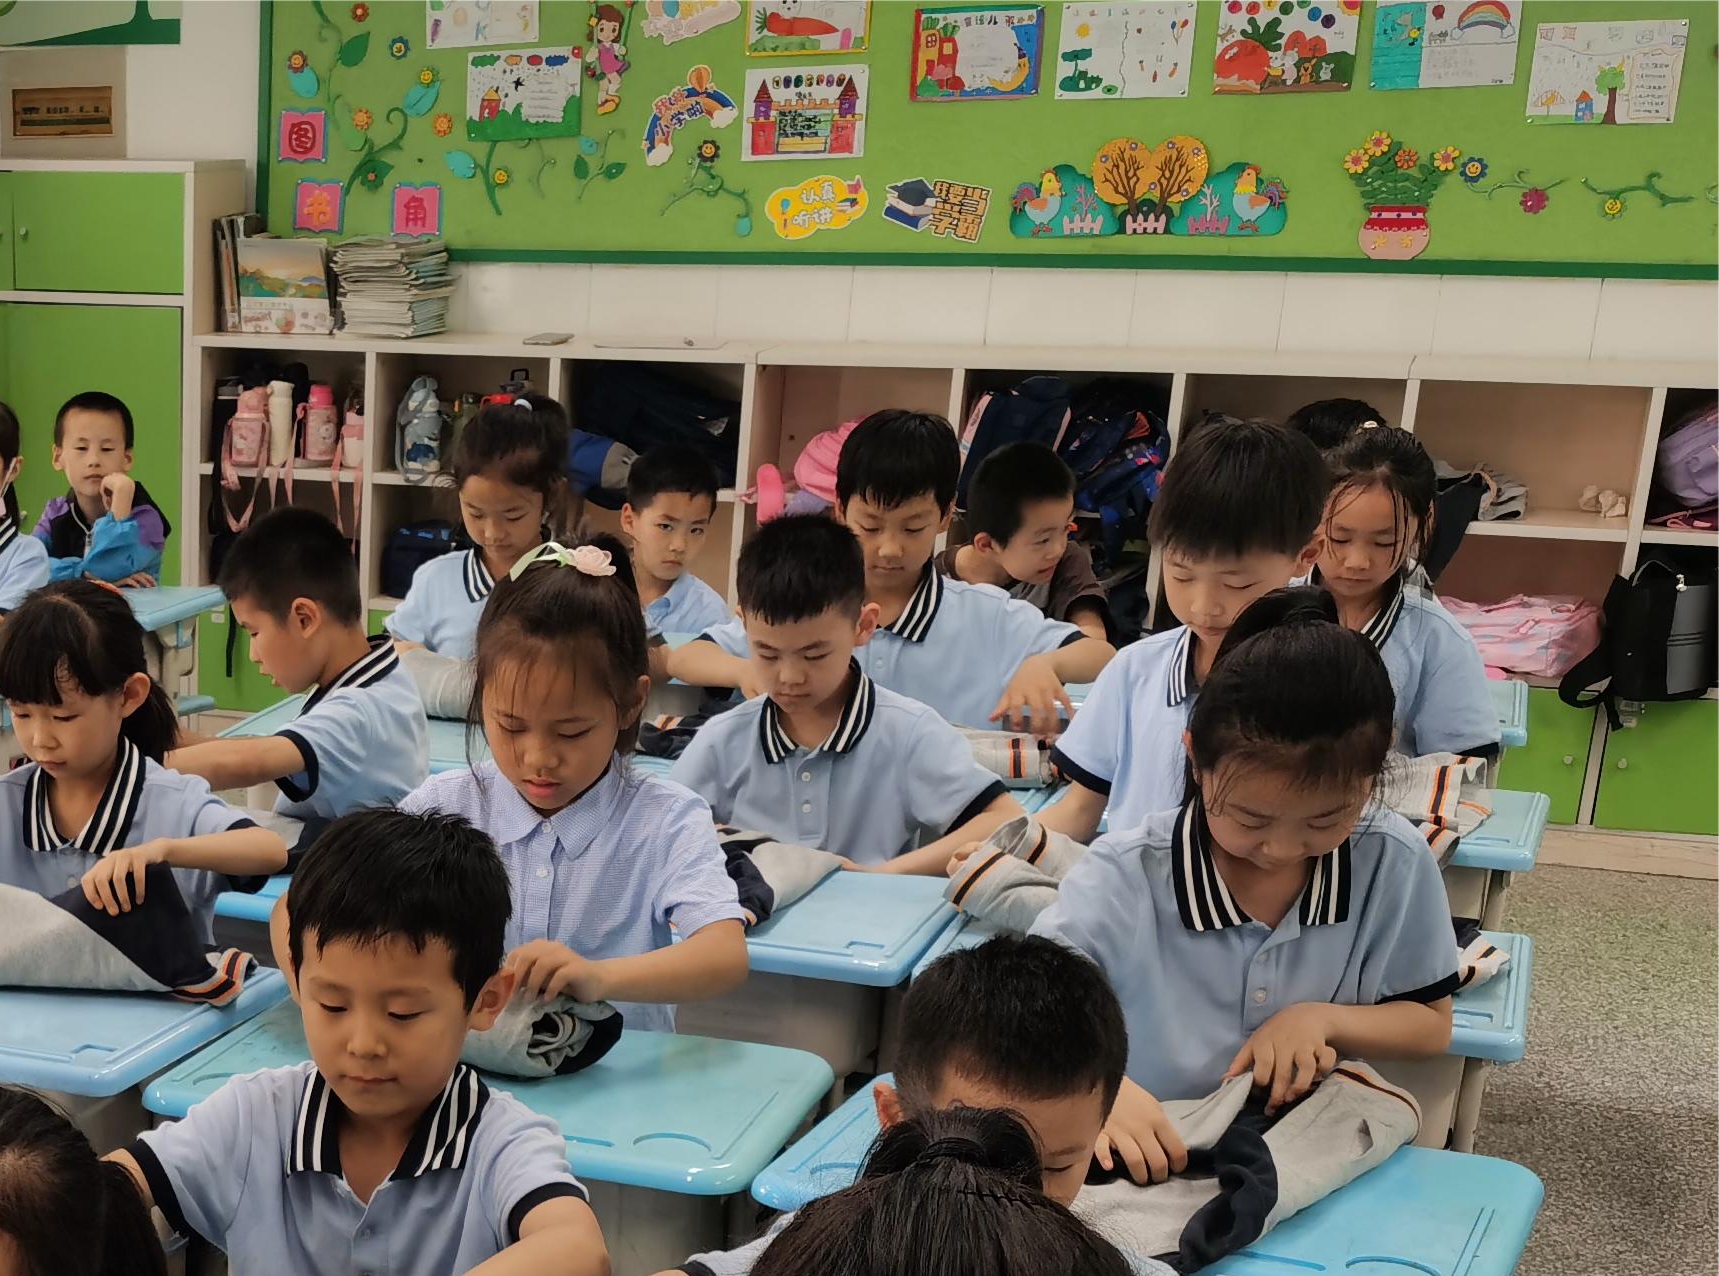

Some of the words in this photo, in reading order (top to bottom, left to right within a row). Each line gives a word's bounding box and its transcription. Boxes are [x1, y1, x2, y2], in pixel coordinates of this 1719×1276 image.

[288, 120, 317, 155] 图
[304, 189, 331, 226] 书
[801, 181, 835, 204] 认真
[933, 181, 990, 218] 我要当
[403, 194, 427, 229] 角
[793, 206, 833, 228] 听讲
[929, 200, 982, 241] 学霸
